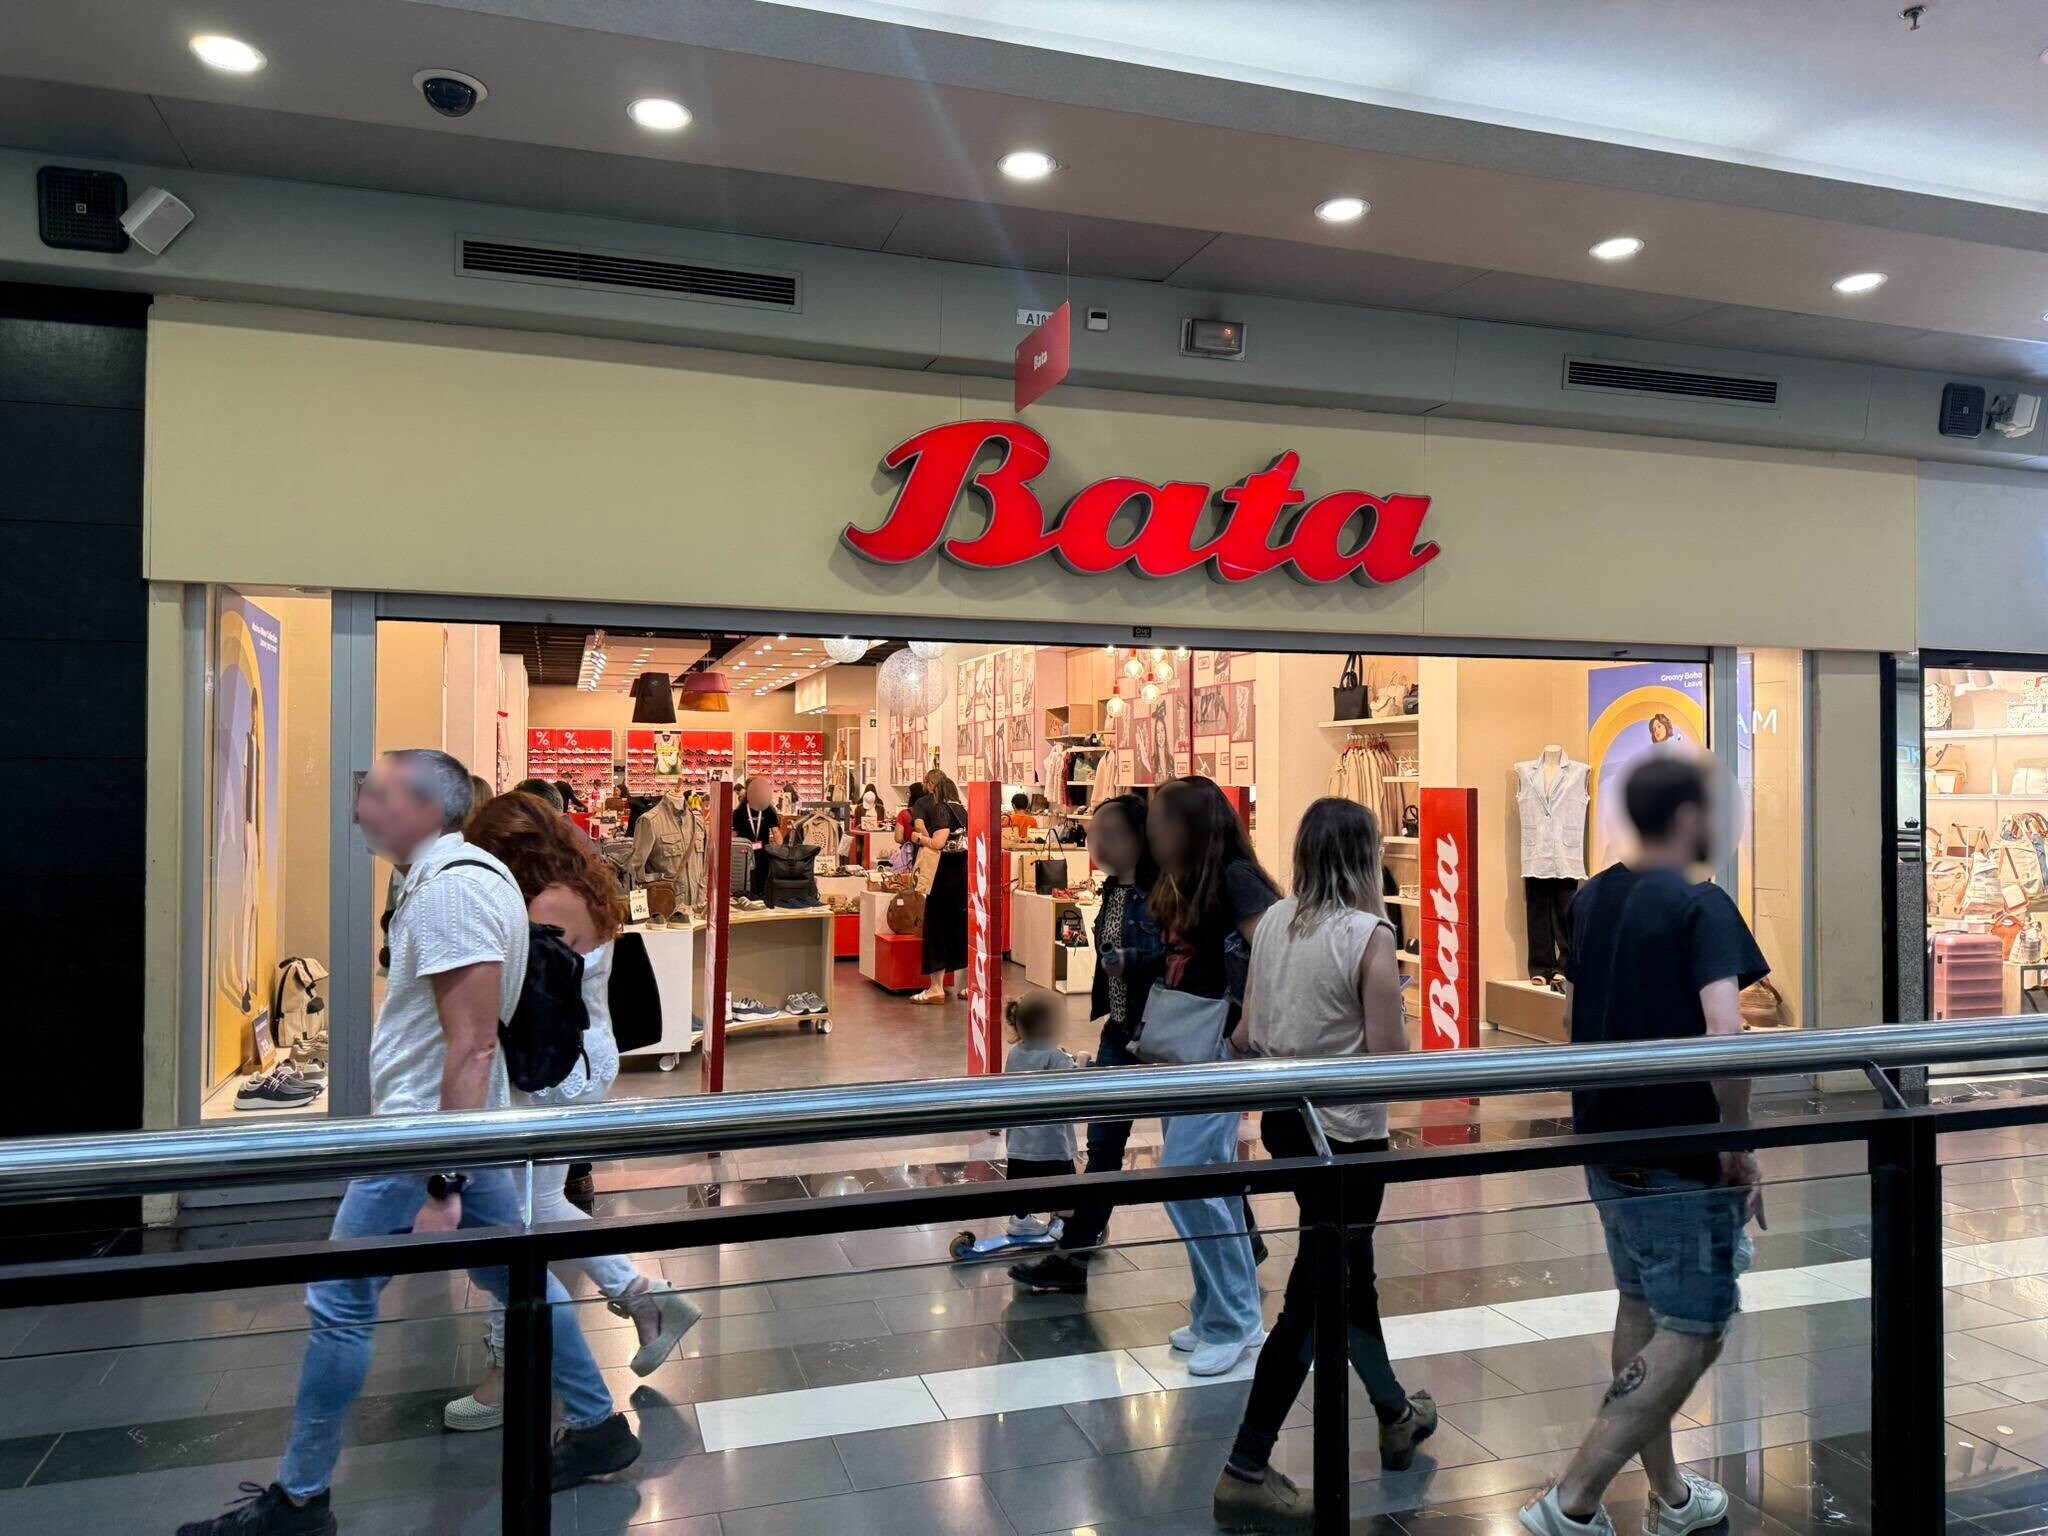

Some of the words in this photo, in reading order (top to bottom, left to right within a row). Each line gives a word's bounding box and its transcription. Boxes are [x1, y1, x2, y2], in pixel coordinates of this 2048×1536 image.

[1026, 312, 1053, 326] A10
[1033, 350, 1048, 371] Bata
[841, 418, 1442, 587] Bata
[1660, 673, 1683, 682] Groovy
[1684, 671, 1703, 680] Boho
[970, 831, 987, 1074] Bata
[1429, 832, 1459, 1049] Bata
